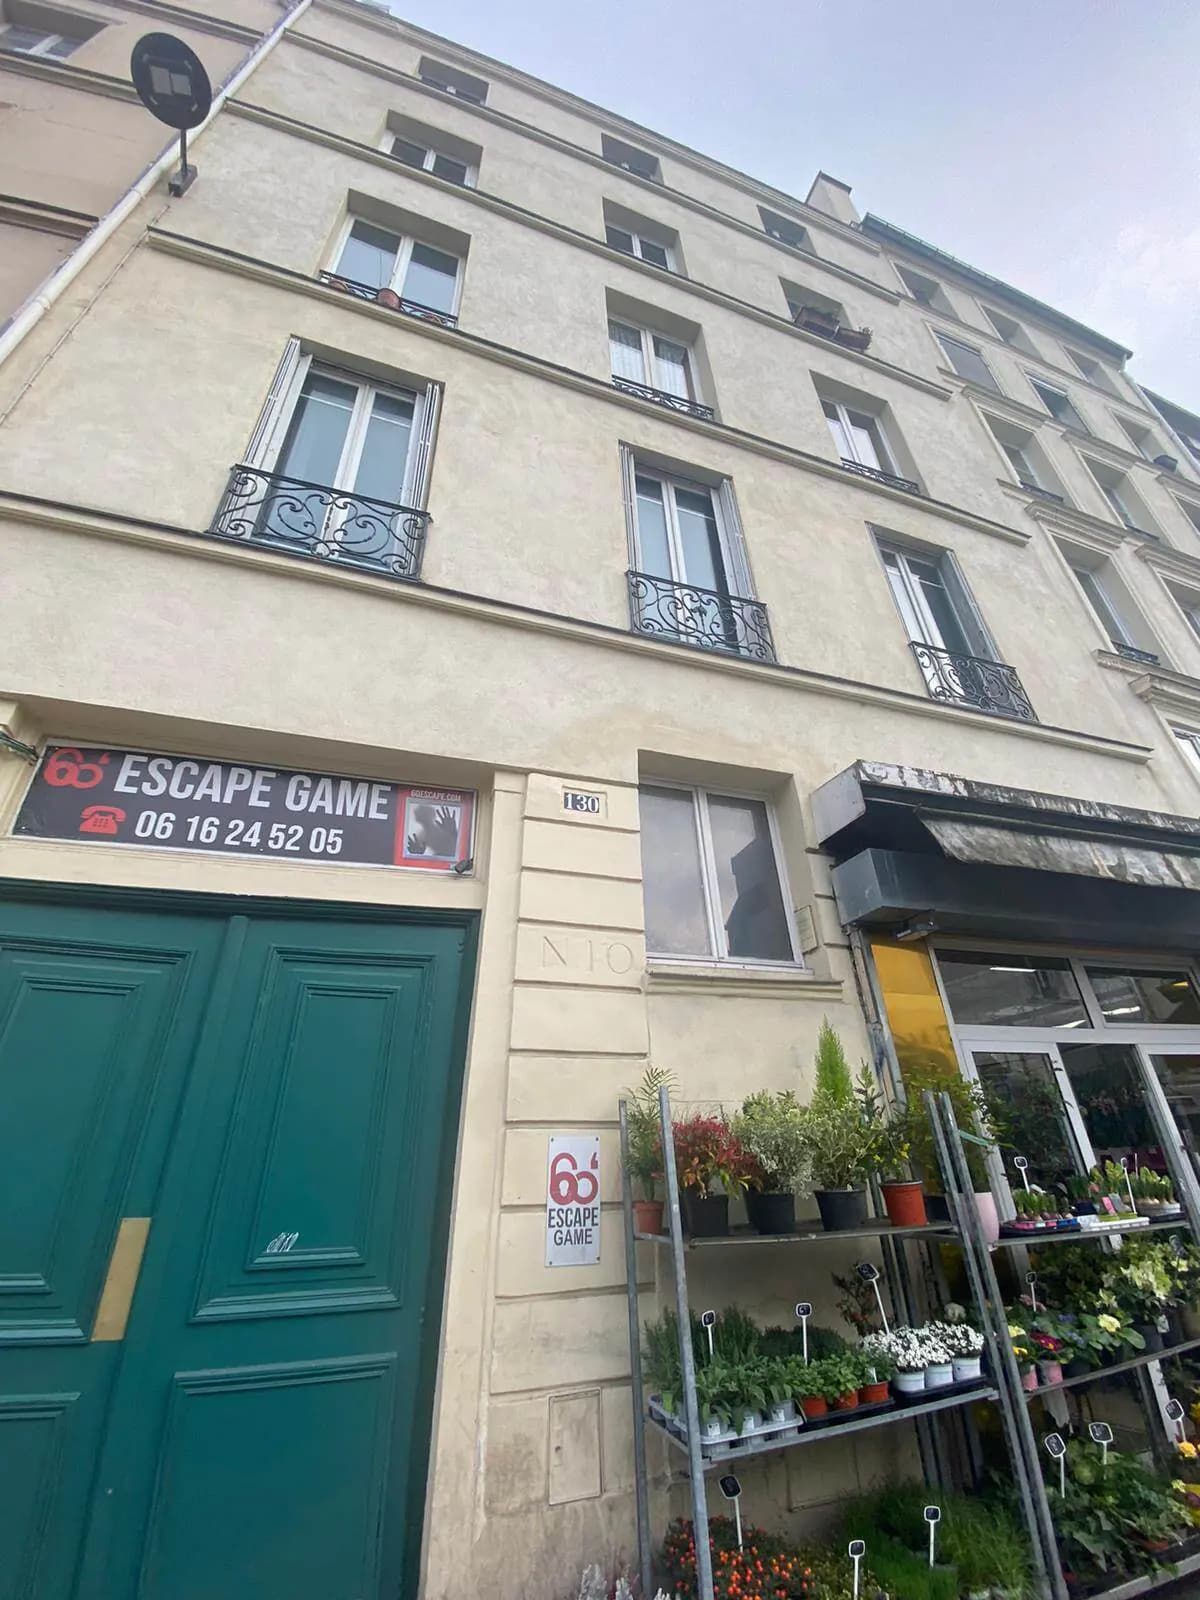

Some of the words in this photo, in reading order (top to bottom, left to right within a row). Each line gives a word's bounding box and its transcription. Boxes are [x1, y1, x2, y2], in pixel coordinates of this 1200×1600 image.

[113, 754, 276, 807] ESCAPE
[284, 775, 392, 820] GAME
[565, 793, 599, 813] 130
[134, 810, 176, 839] 06
[186, 815, 220, 844] 16
[267, 823, 303, 851] 52
[308, 827, 344, 855] 05
[548, 1207, 599, 1228] ESCAPE
[553, 1228, 593, 1246] GAME
